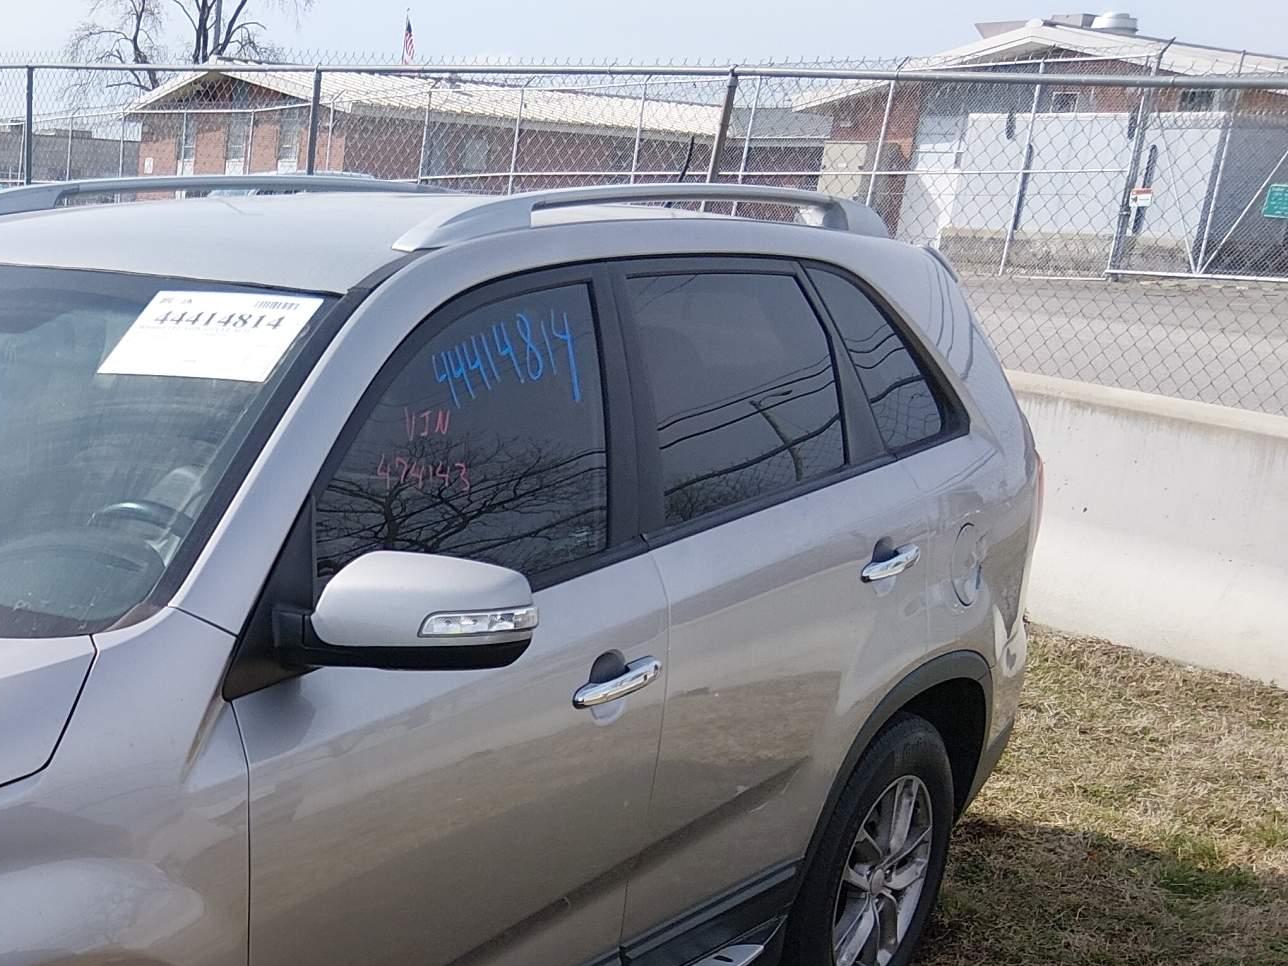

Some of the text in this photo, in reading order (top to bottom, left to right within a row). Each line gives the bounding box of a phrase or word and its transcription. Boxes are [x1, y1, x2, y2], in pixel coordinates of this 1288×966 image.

[154, 310, 286, 330] 44414814
[431, 310, 581, 409] 44414814
[402, 406, 452, 440] VIN
